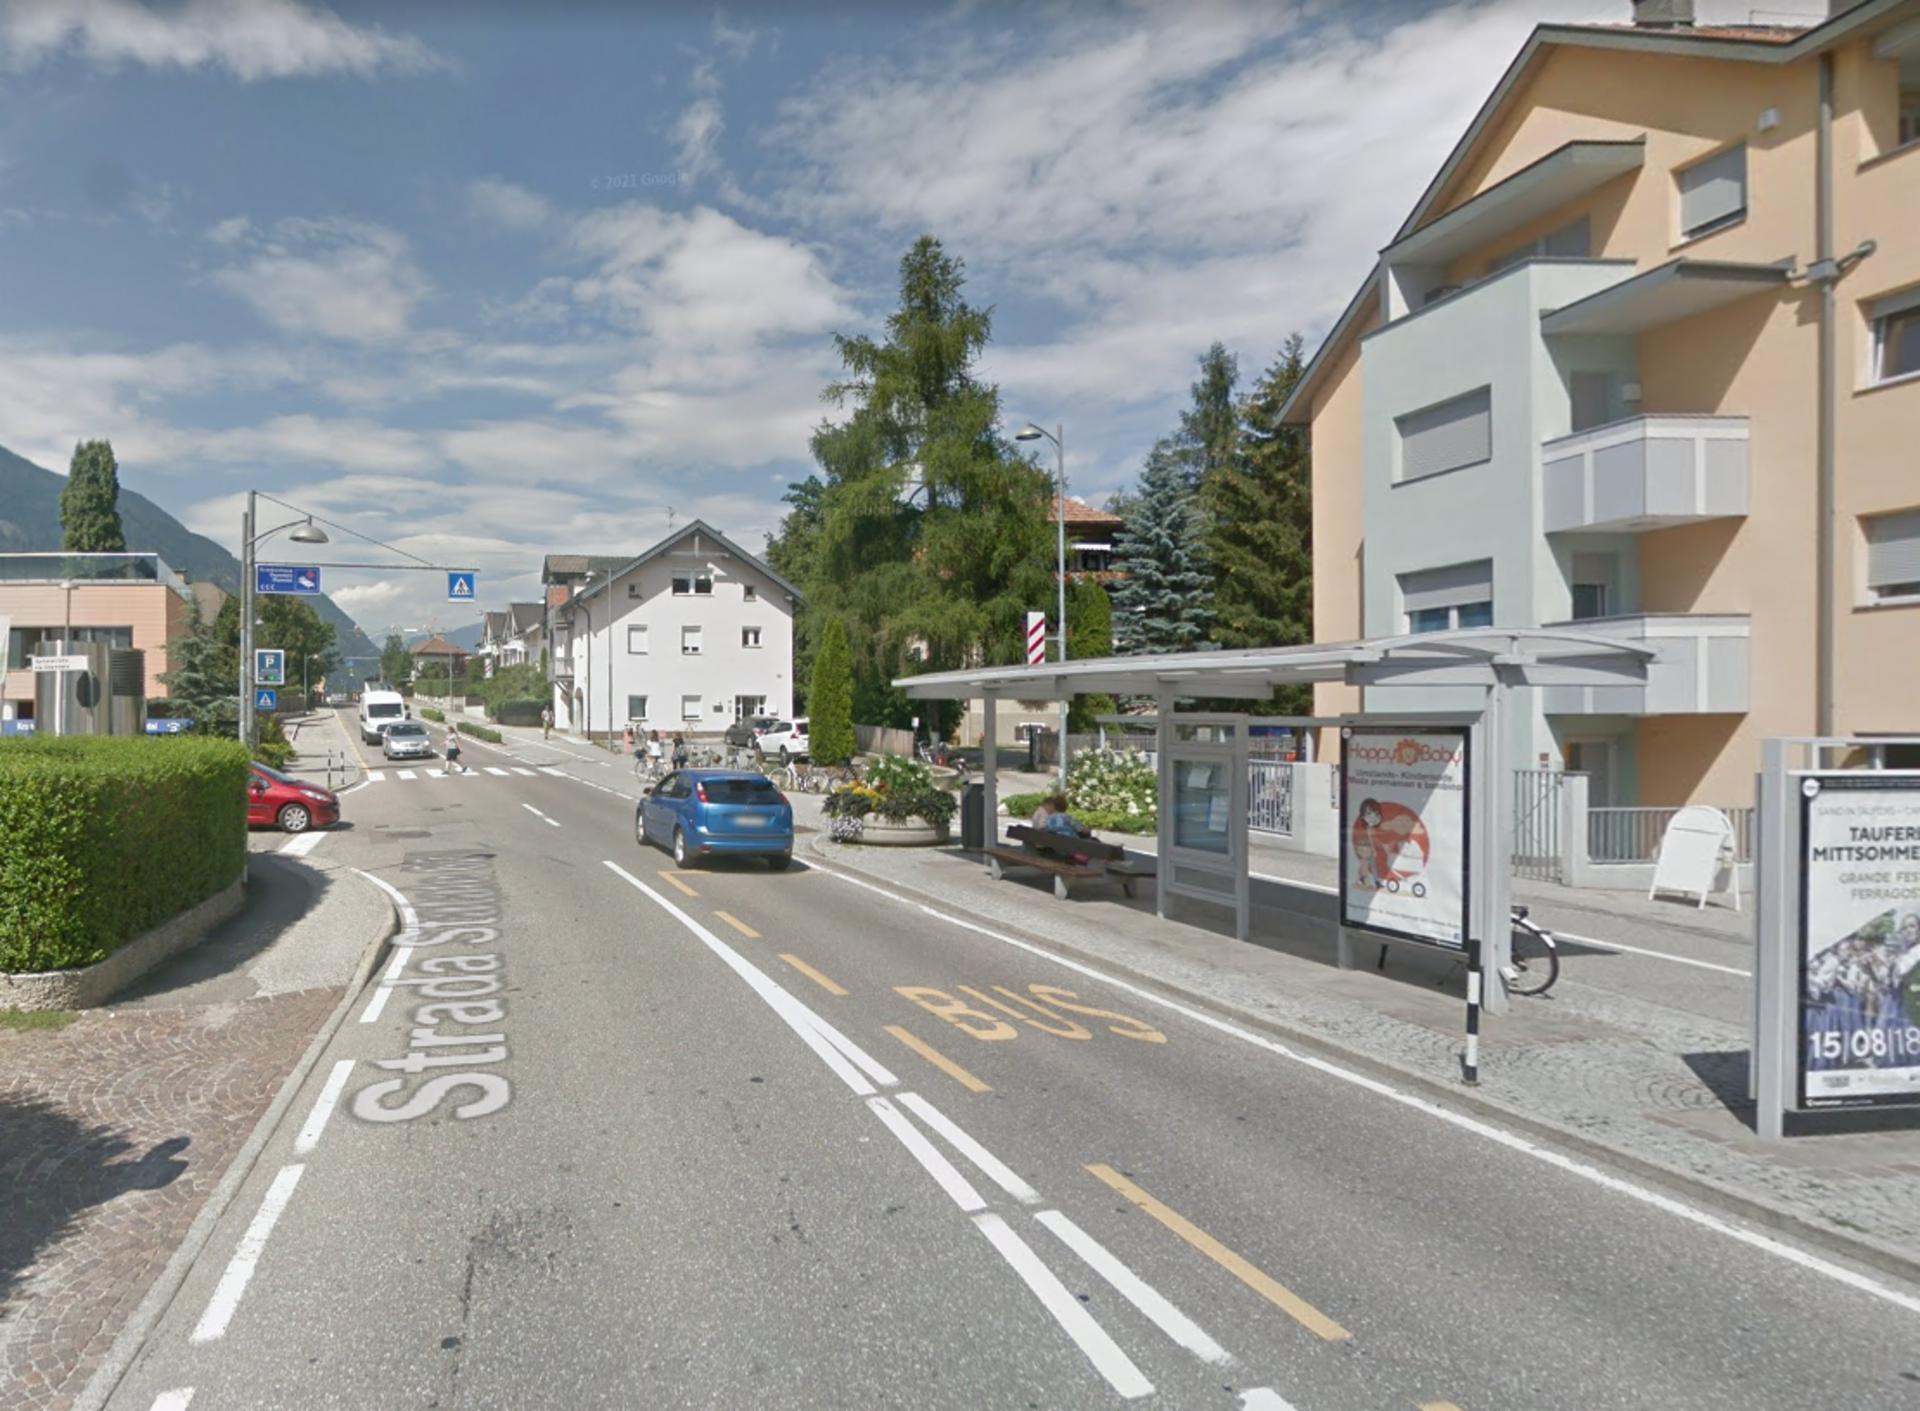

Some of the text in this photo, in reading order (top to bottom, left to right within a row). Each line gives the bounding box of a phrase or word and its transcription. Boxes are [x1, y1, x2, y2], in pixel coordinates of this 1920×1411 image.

[265, 657, 275, 668] P
[1347, 743, 1463, 767] Happy Baby
[1838, 871, 1920, 884] GRANDE FES
[891, 983, 1168, 1044] BUS
